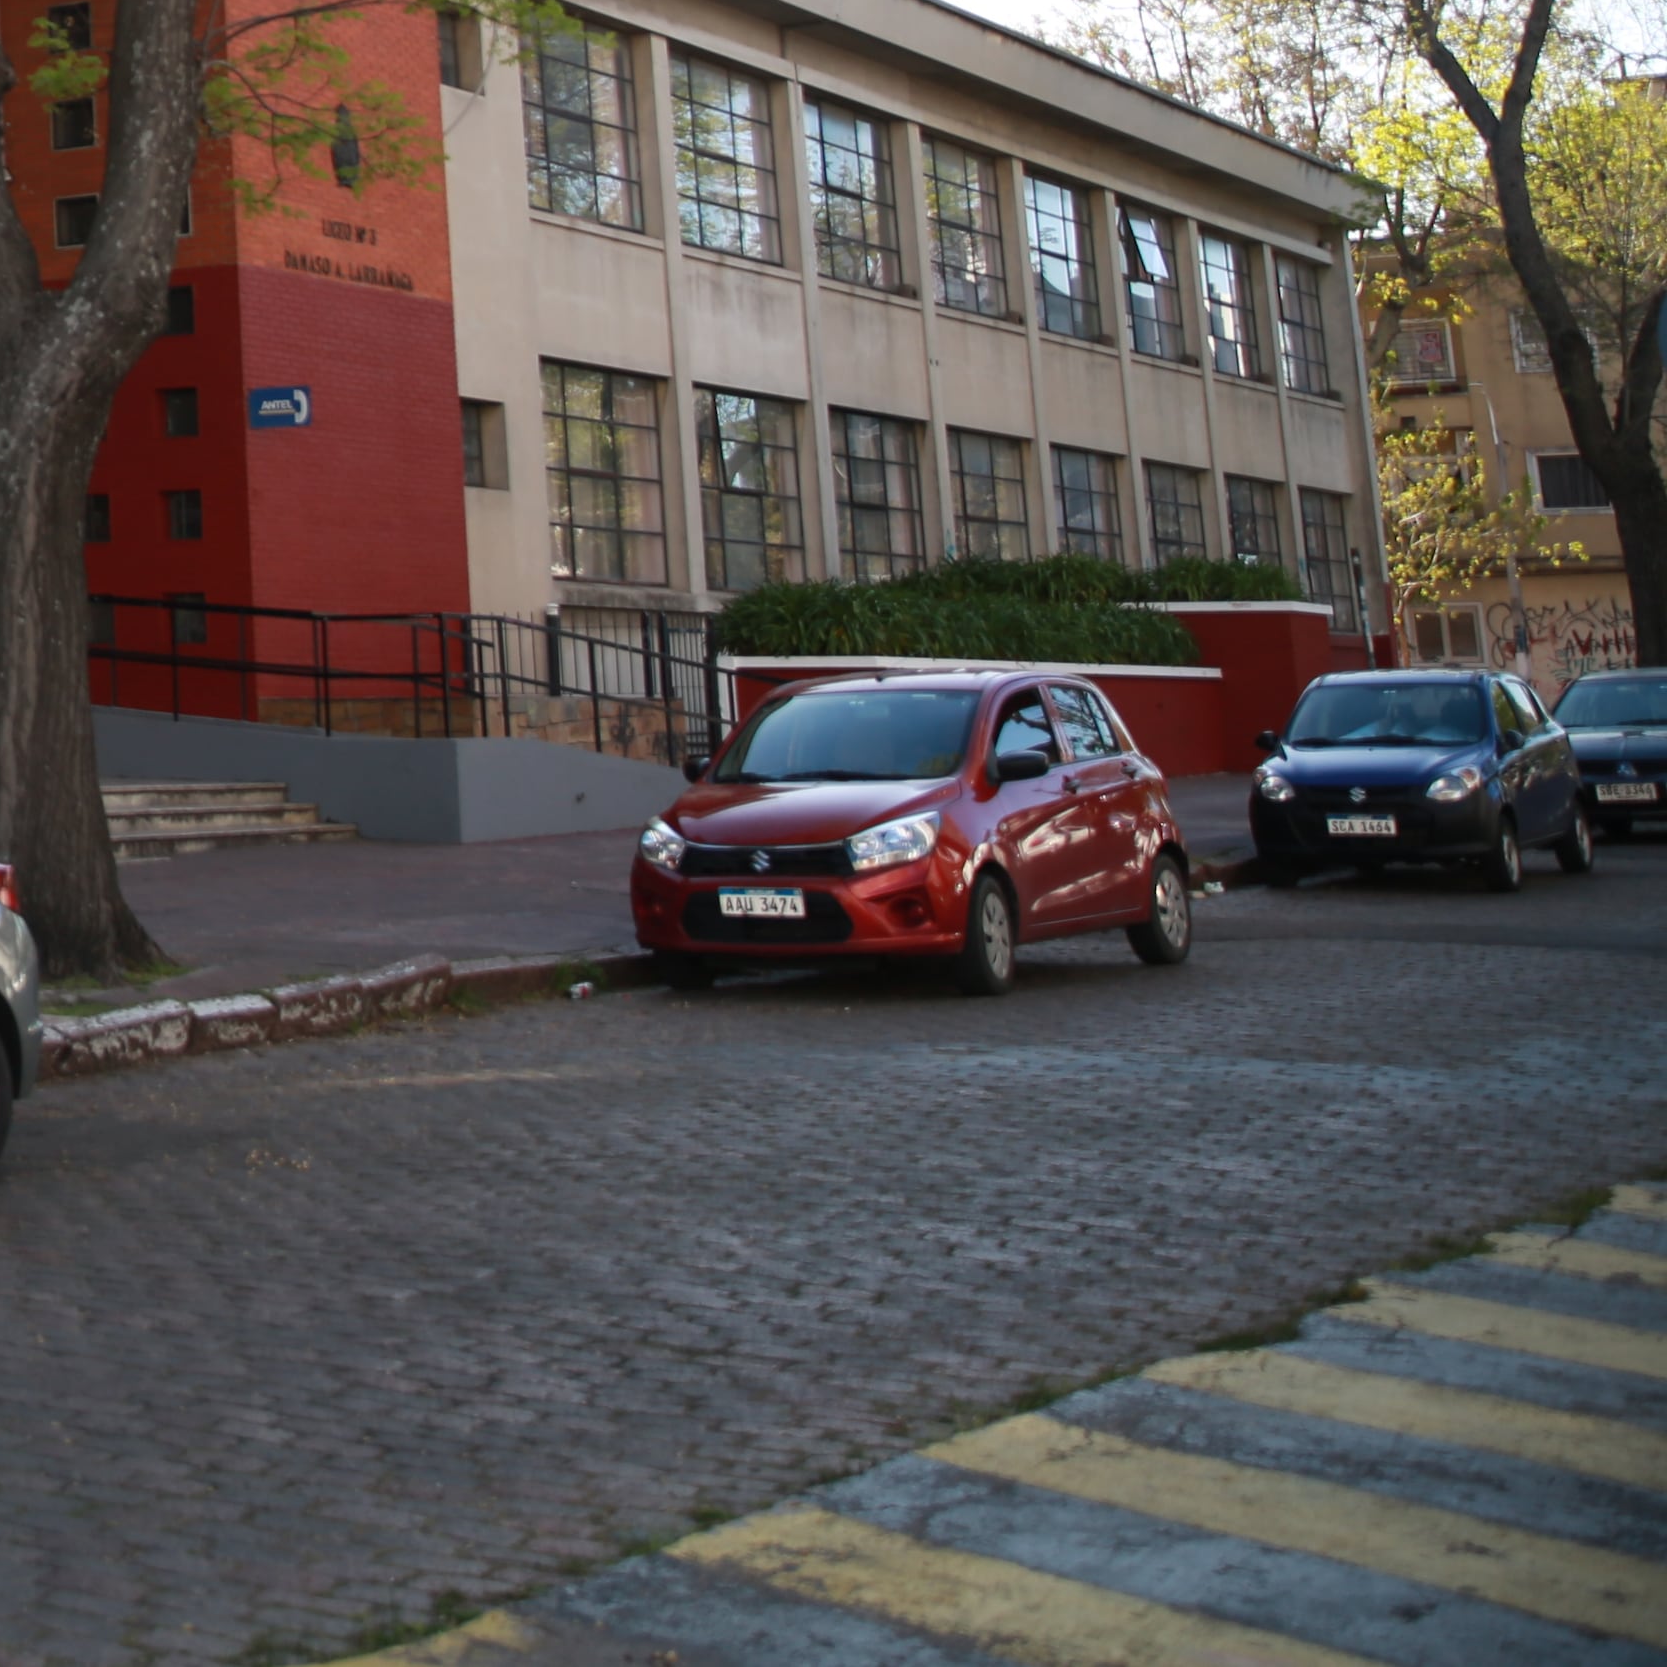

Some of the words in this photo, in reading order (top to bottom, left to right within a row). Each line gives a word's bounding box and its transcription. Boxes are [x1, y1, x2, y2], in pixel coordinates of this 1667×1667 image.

[322, 218, 352, 241] LICEO
[284, 249, 331, 276] DAMASO
[261, 399, 293, 410] ANTEL
[726, 896, 753, 912] AAU
[759, 896, 798, 914] 3474
